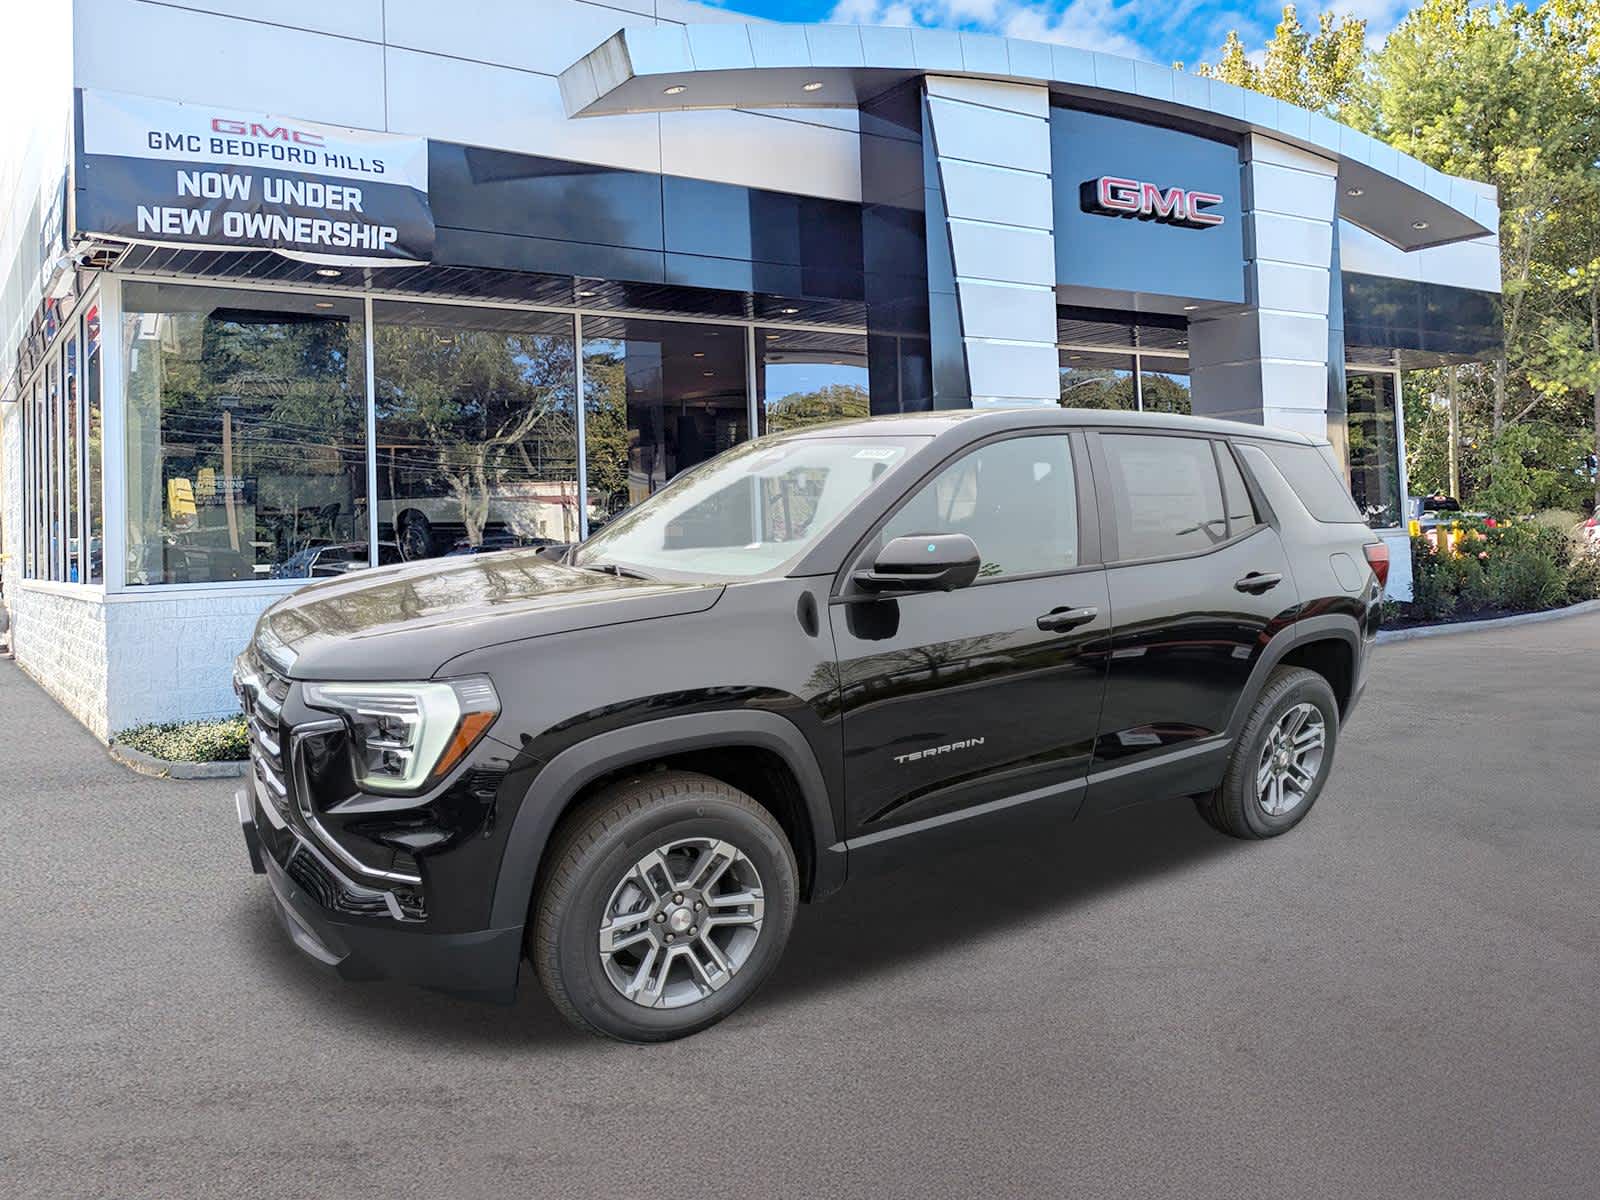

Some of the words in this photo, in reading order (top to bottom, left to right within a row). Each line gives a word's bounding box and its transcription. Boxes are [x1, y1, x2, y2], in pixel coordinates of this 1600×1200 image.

[148, 131, 201, 153] GMC
[210, 138, 316, 165] BEDFORD
[324, 153, 385, 174] HILLS
[211, 118, 326, 148] GMC
[177, 170, 252, 201] NOW
[263, 177, 363, 213] UNDER
[1097, 175, 1225, 225] GMC
[137, 205, 211, 236] NEW
[223, 211, 398, 250] OWNERSHIP
[893, 736, 985, 764] TERRAIN
